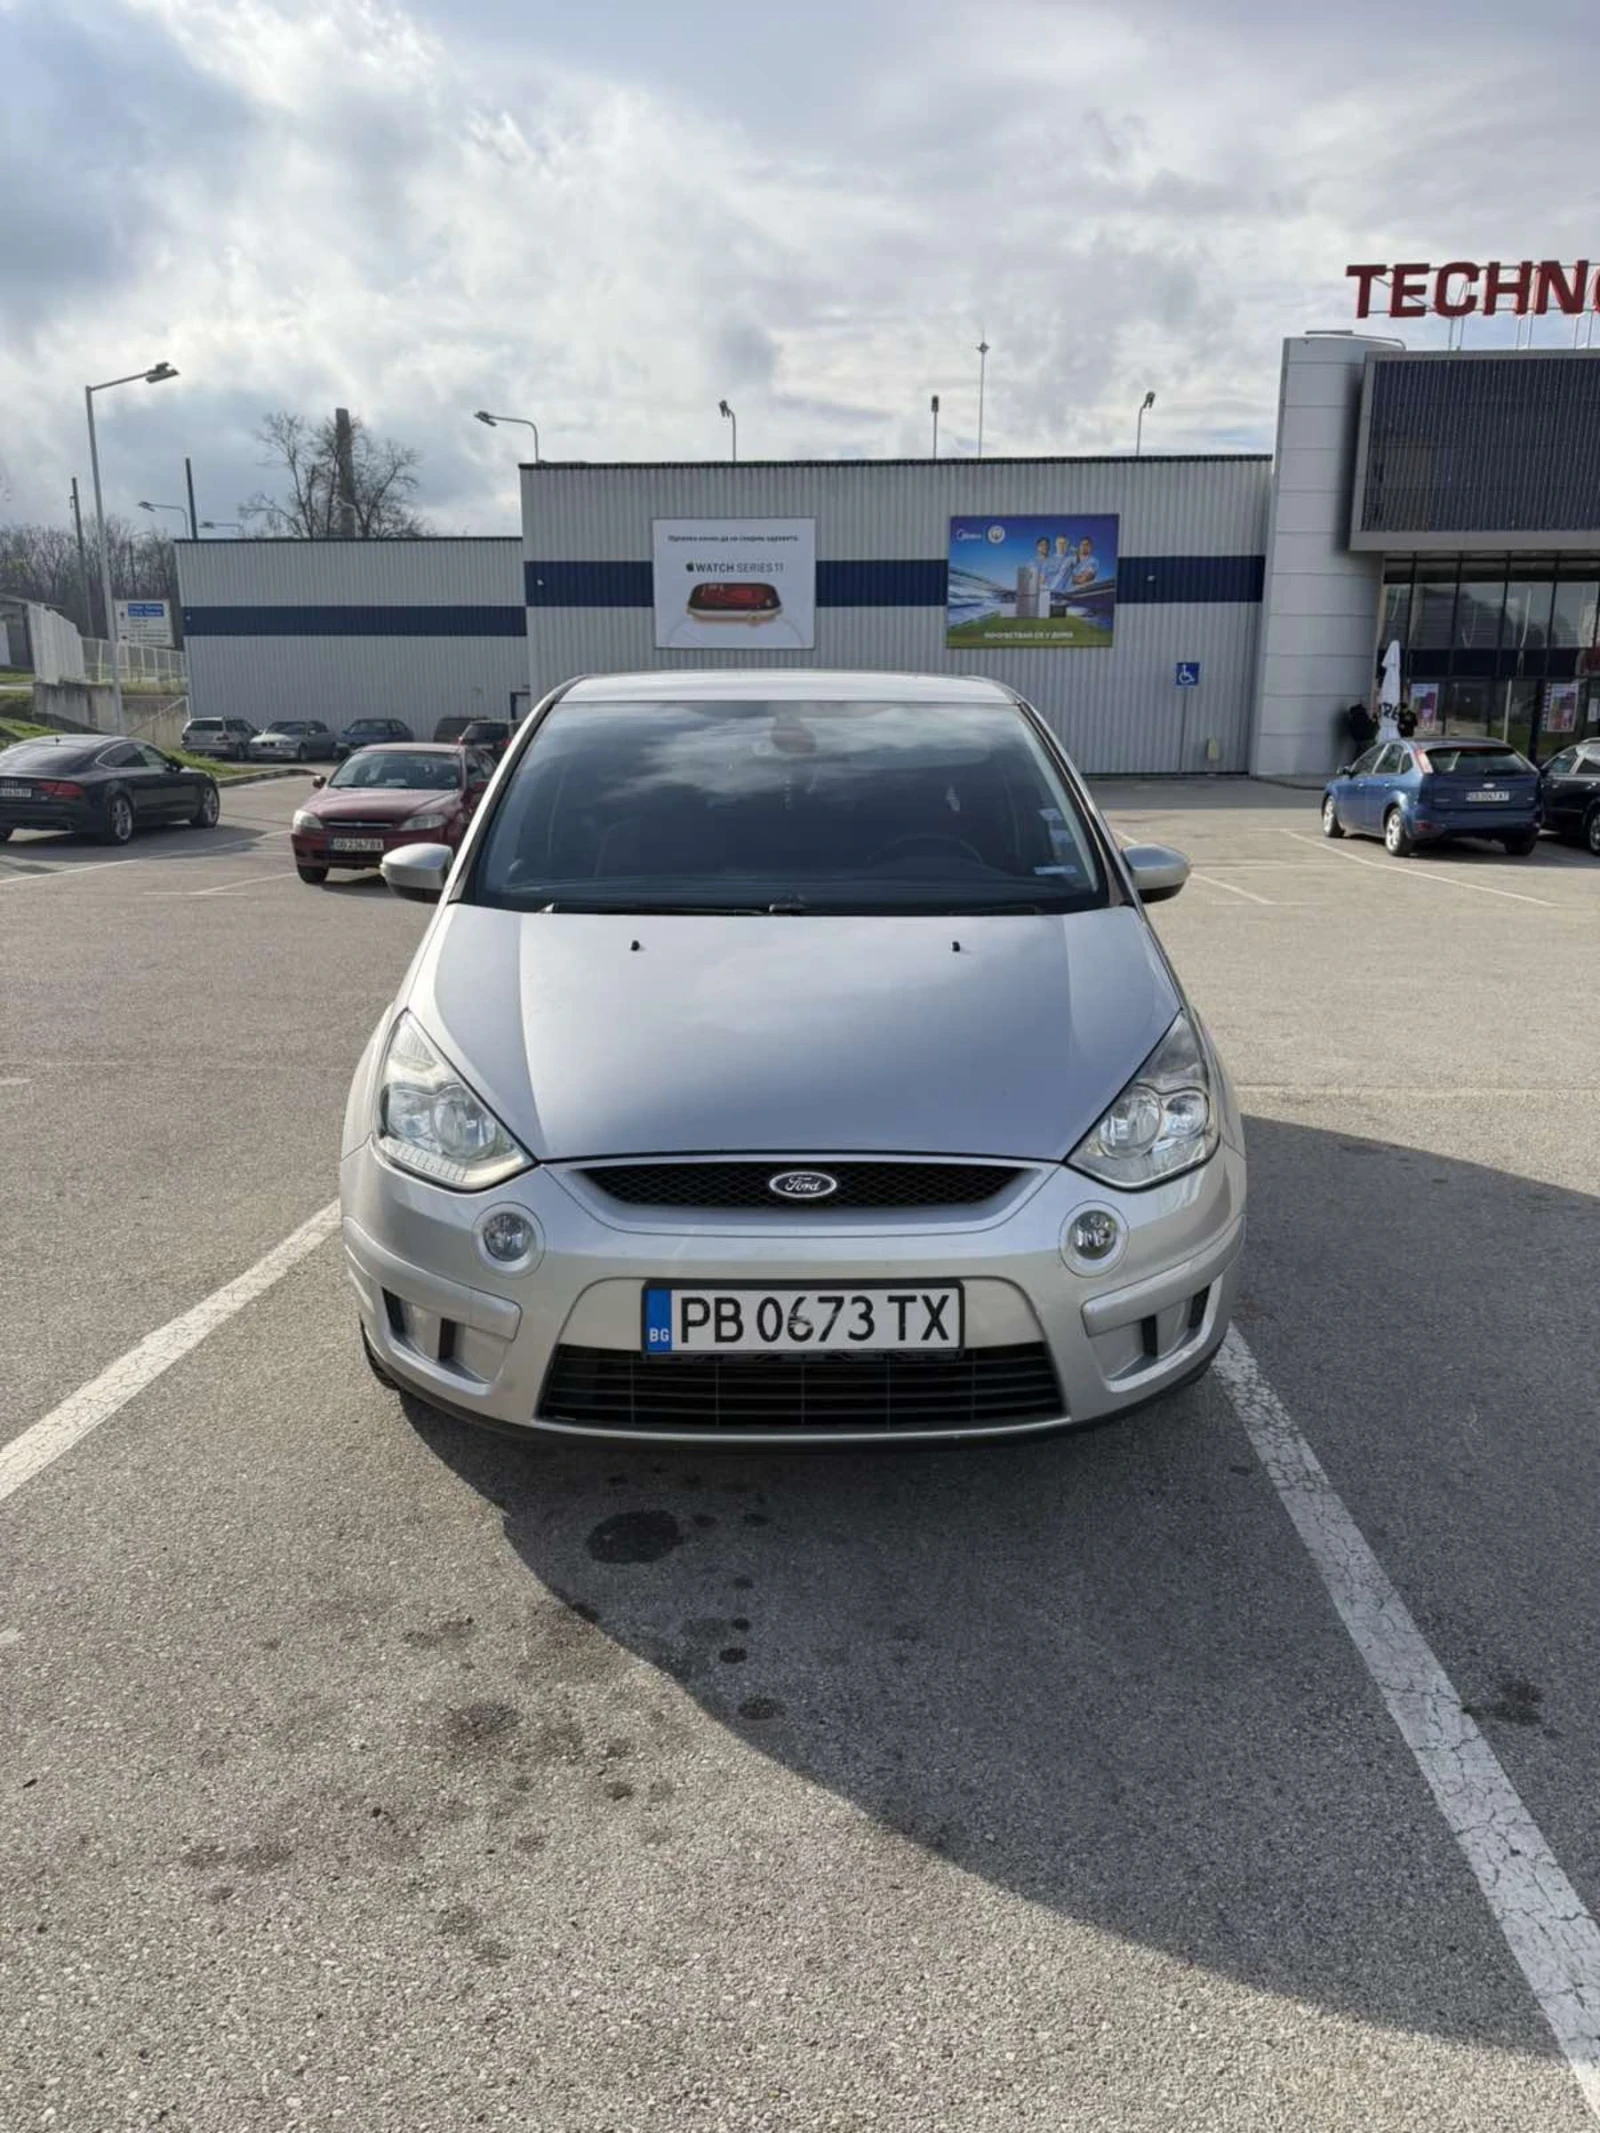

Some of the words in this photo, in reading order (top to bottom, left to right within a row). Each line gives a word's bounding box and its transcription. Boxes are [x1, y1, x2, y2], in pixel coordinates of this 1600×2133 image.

[1346, 260, 1600, 319] TECHN
[695, 563, 734, 573] WATCH
[736, 563, 772, 573] SERIES
[784, 1176, 821, 1191] Ford
[681, 1297, 744, 1343] PB
[756, 1296, 875, 1342] 0673
[887, 1294, 949, 1341] TX
[649, 1329, 669, 1342] BG
